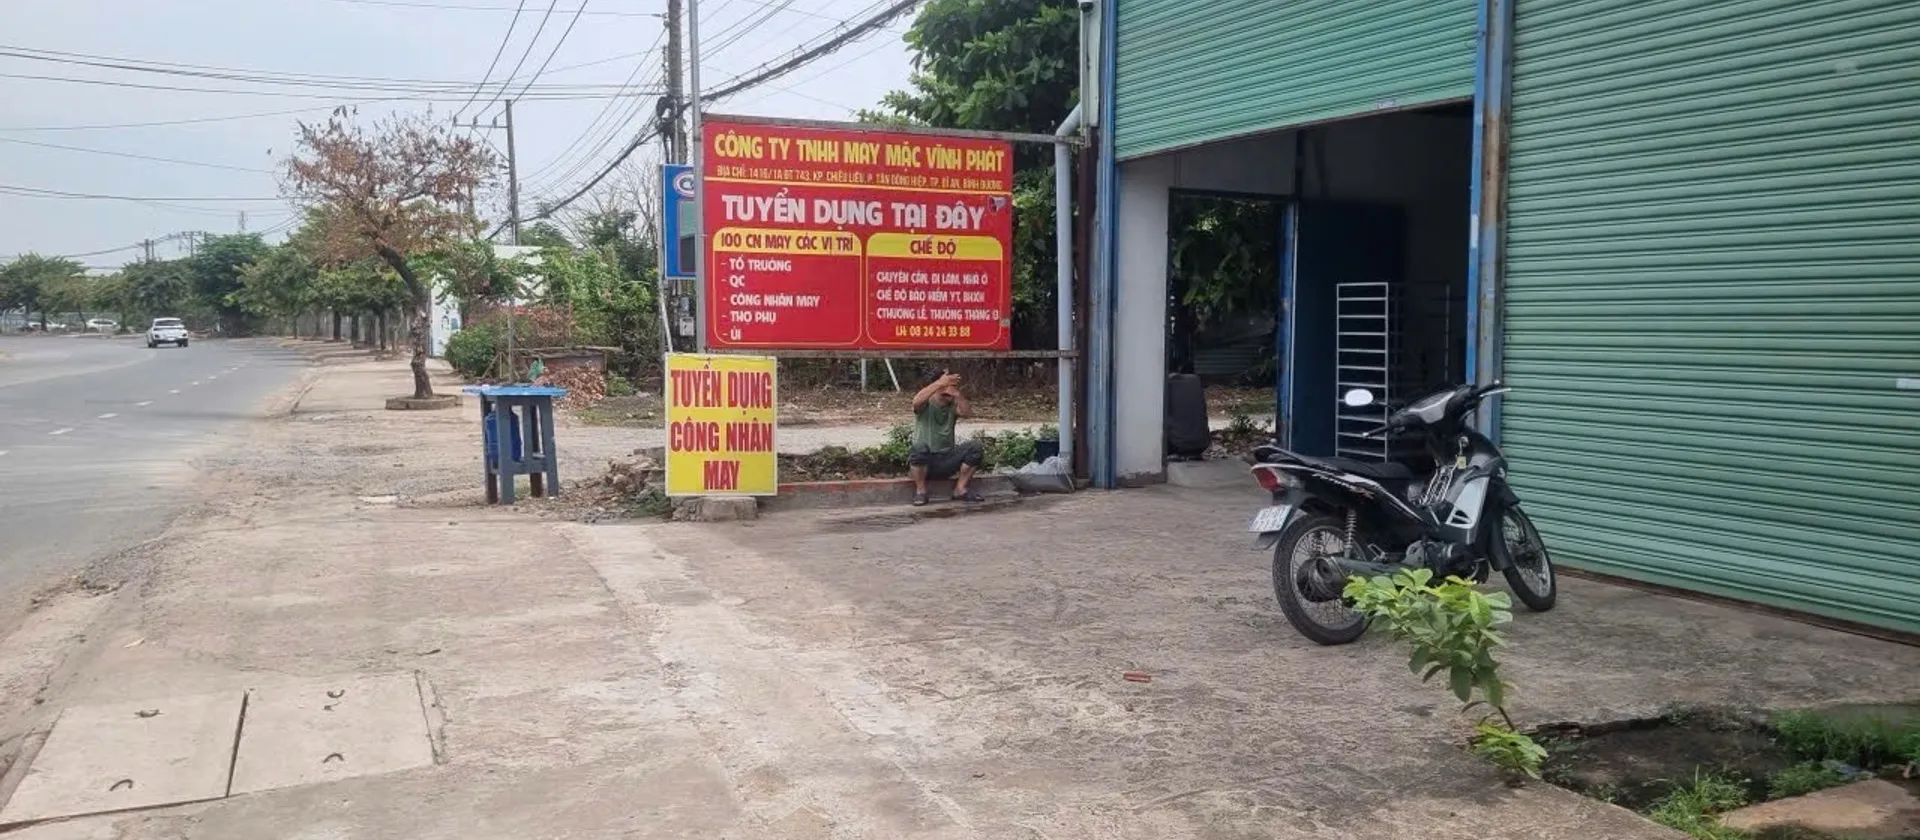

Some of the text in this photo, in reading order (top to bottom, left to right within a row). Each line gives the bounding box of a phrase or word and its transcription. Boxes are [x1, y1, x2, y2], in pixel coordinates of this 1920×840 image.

[714, 129, 1005, 172] CÔNG TY TNHH MAY MẶC VĨNH PHÁT
[721, 187, 985, 234] TUYỂN DỤNG TẠI ĐÂY
[721, 233, 854, 256] 100 CN MAY CÁC VỊ TRÍ
[910, 235, 956, 260] CHẾ ĐỘ
[729, 275, 745, 287] QC
[730, 292, 820, 307] CÔNG NHÂN MAY
[909, 325, 921, 337] 08
[671, 358, 772, 415] TUYỂN DỤNG
[670, 416, 772, 453] CÔNG NHÂN
[703, 460, 741, 491] MAY
